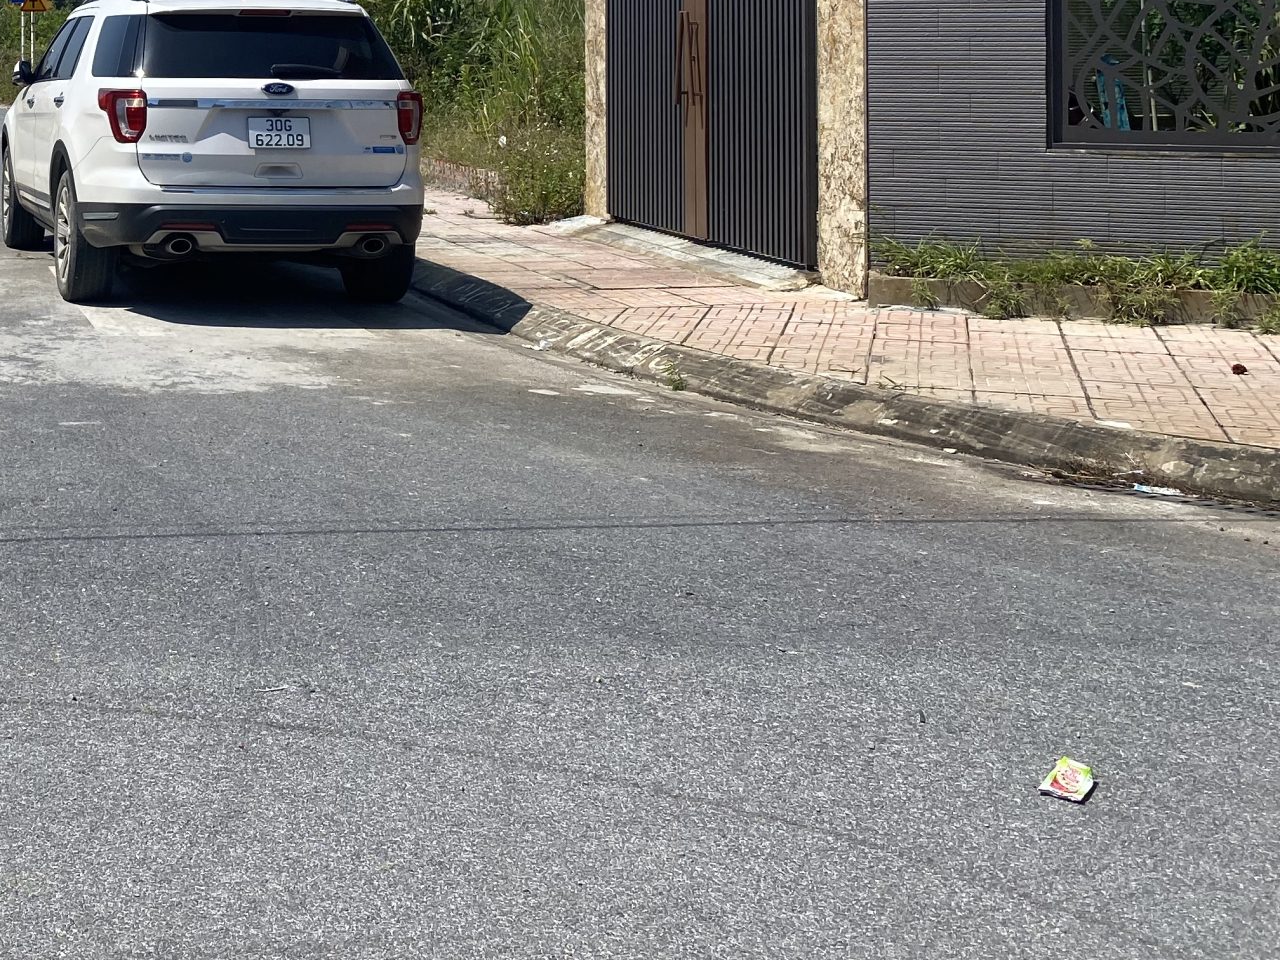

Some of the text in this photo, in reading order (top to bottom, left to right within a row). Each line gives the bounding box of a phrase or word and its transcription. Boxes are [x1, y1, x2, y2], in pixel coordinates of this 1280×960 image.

[267, 83, 290, 93] Ford
[266, 119, 292, 132] 30G
[255, 133, 304, 147] 622.09
